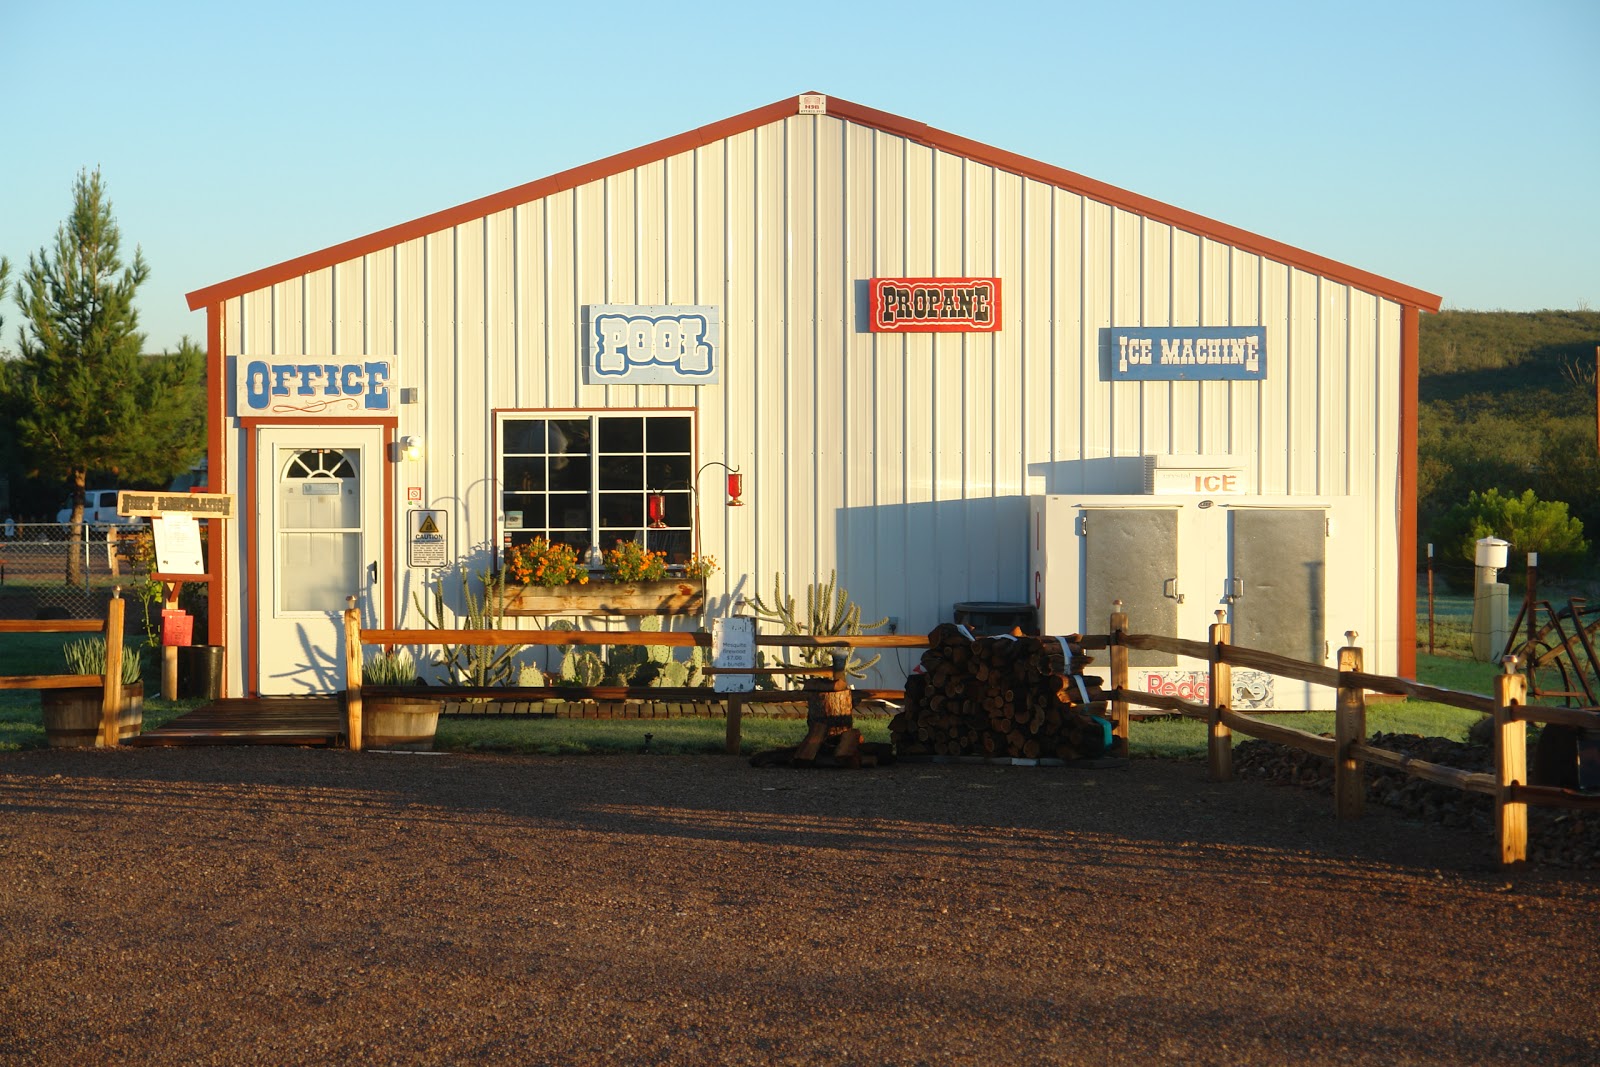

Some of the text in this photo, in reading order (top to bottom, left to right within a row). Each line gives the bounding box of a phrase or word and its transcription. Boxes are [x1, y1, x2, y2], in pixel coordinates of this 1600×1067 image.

[882, 285, 990, 323] PROPANE
[598, 315, 711, 374] POOL
[1119, 335, 1259, 372] ICE MACHINE
[246, 360, 391, 410] OFFICE
[1195, 474, 1237, 492] ICE
[1147, 674, 1210, 700] Redd
